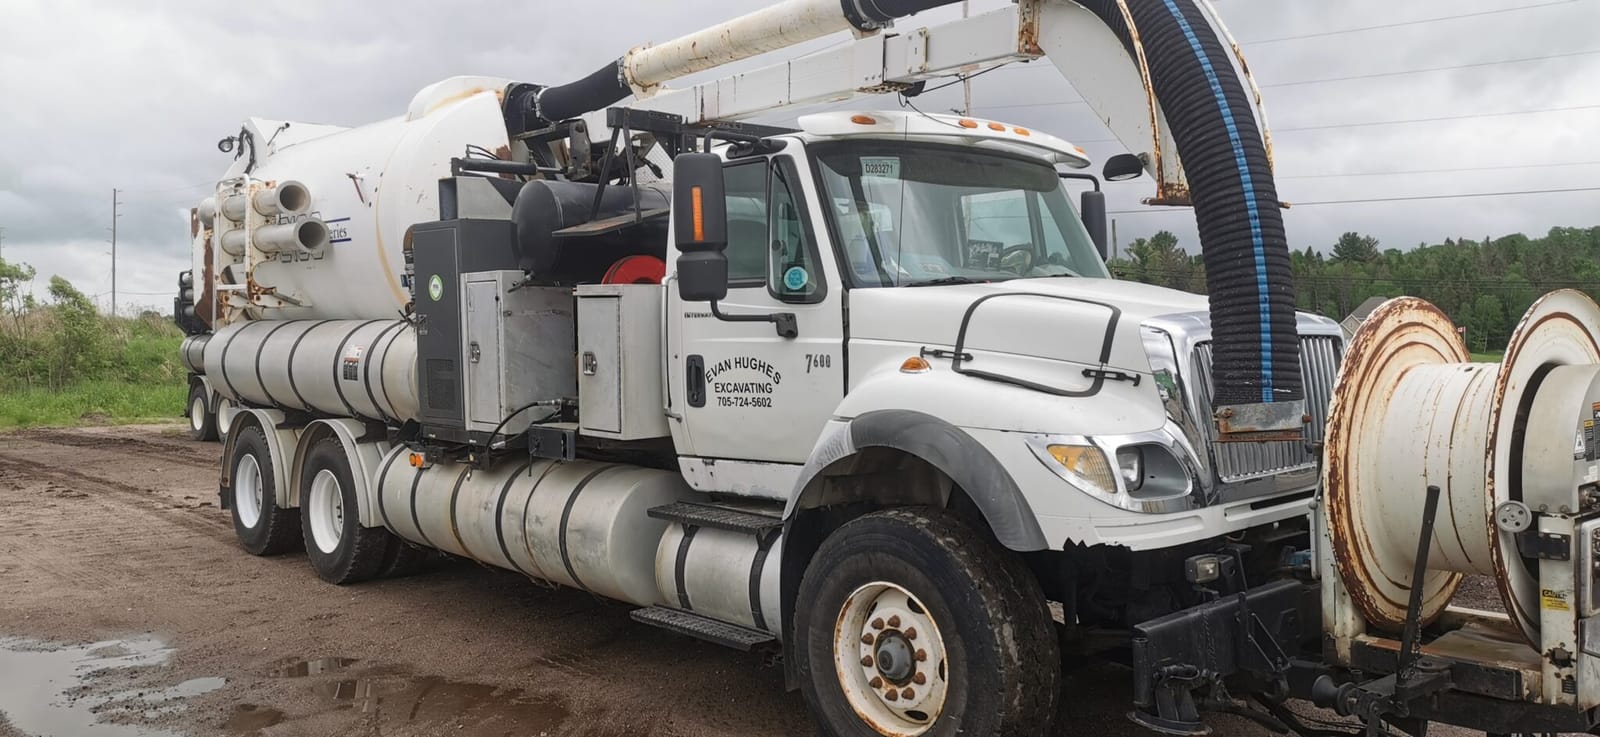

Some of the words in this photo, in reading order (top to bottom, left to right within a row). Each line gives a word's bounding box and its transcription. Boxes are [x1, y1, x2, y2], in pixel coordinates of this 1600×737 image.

[328, 223, 348, 239] eries
[705, 359, 731, 383] EVAN
[734, 356, 782, 385] HUGHES
[805, 354, 831, 374] 7600
[714, 382, 773, 394] EXCAVATING
[717, 396, 772, 408] 705-724-5602
